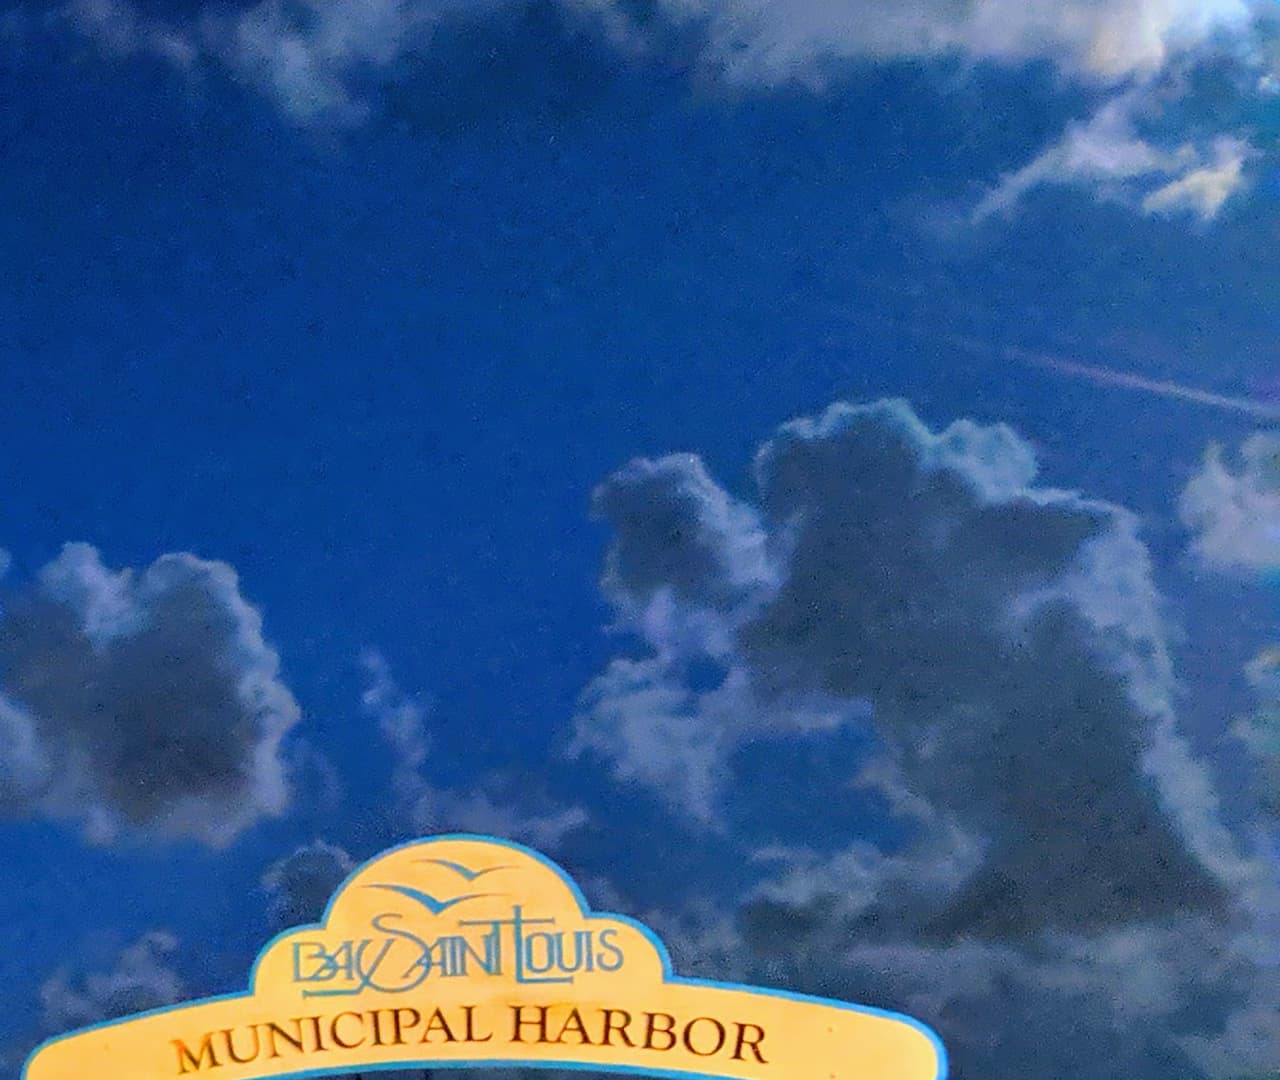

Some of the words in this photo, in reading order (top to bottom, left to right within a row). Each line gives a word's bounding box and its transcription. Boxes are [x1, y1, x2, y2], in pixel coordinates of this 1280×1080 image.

[292, 938, 398, 998] BAY
[365, 913, 520, 993] SAINT
[512, 904, 624, 984] LOUIS
[170, 1005, 492, 1075] MUNICIPAL
[508, 1005, 769, 1064] HARBOR
